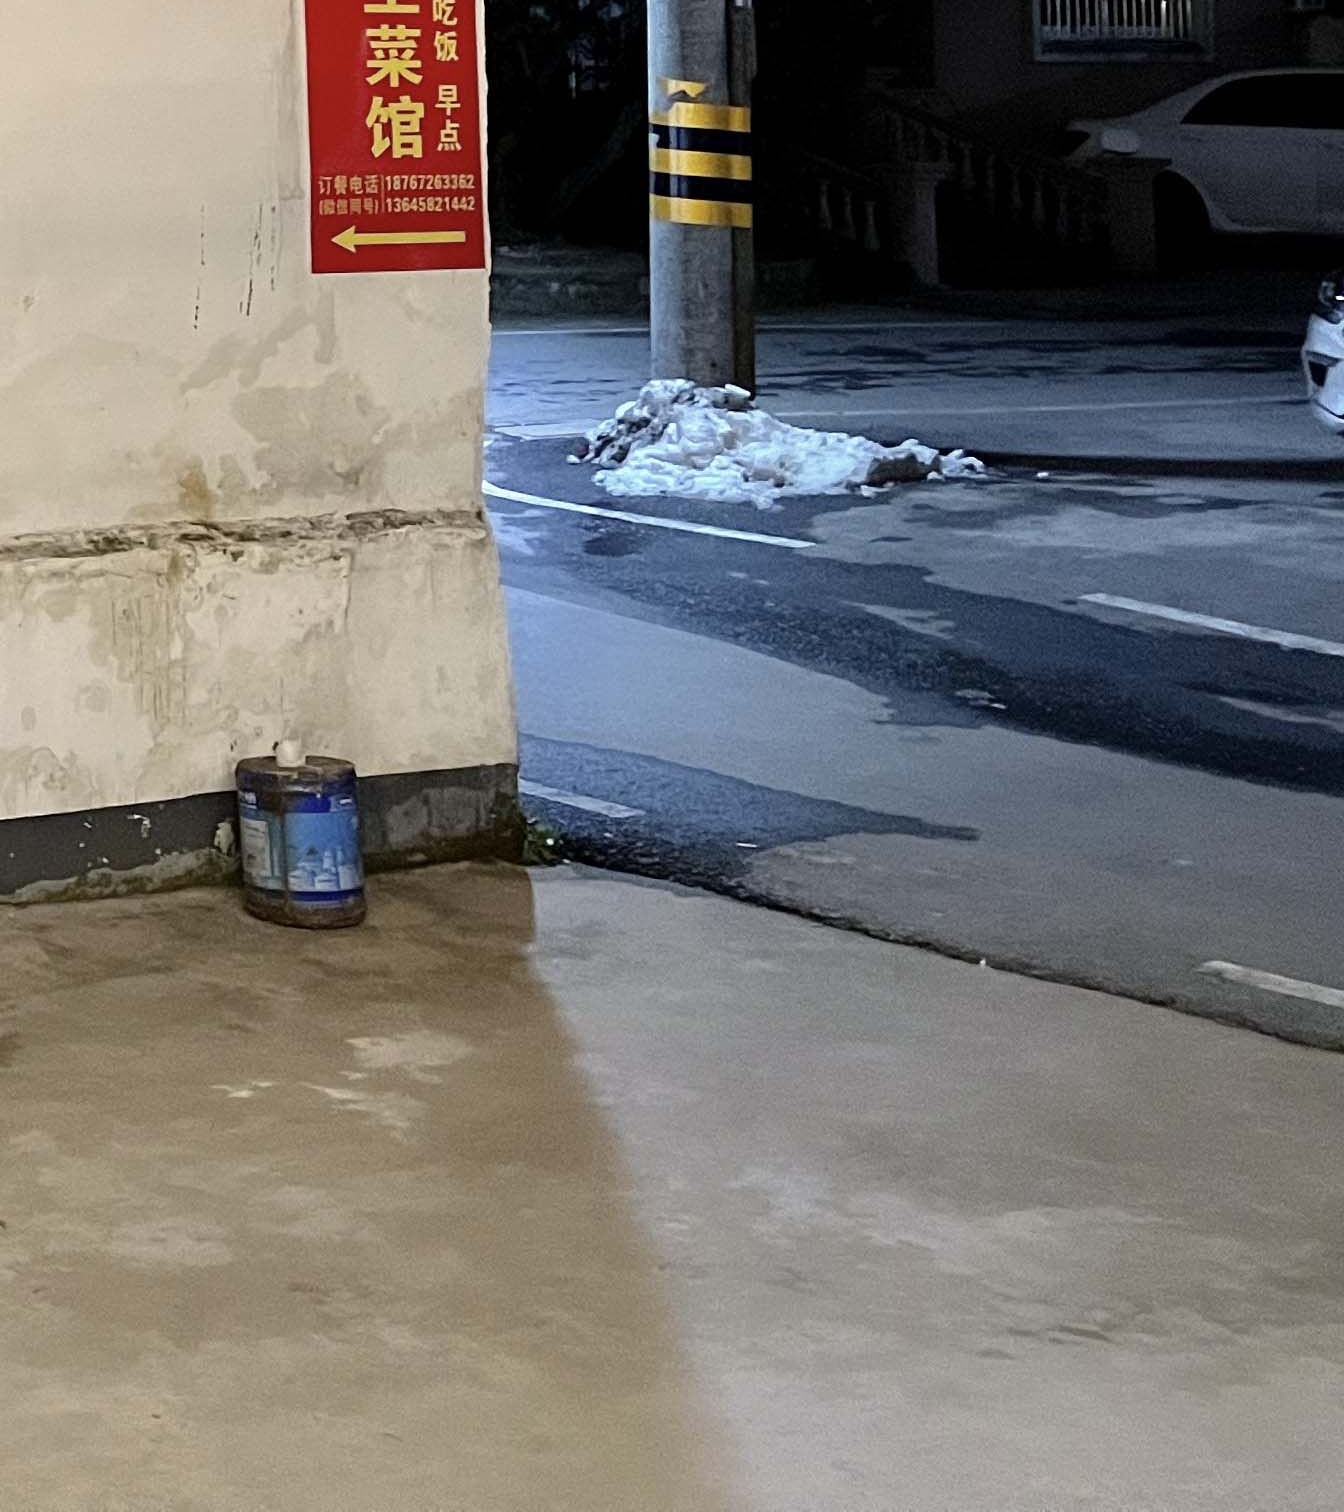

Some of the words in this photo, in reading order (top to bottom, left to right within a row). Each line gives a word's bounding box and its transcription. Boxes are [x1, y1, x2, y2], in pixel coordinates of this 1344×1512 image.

[435, 84, 462, 151] 早点
[318, 174, 379, 195] 订餐电话
